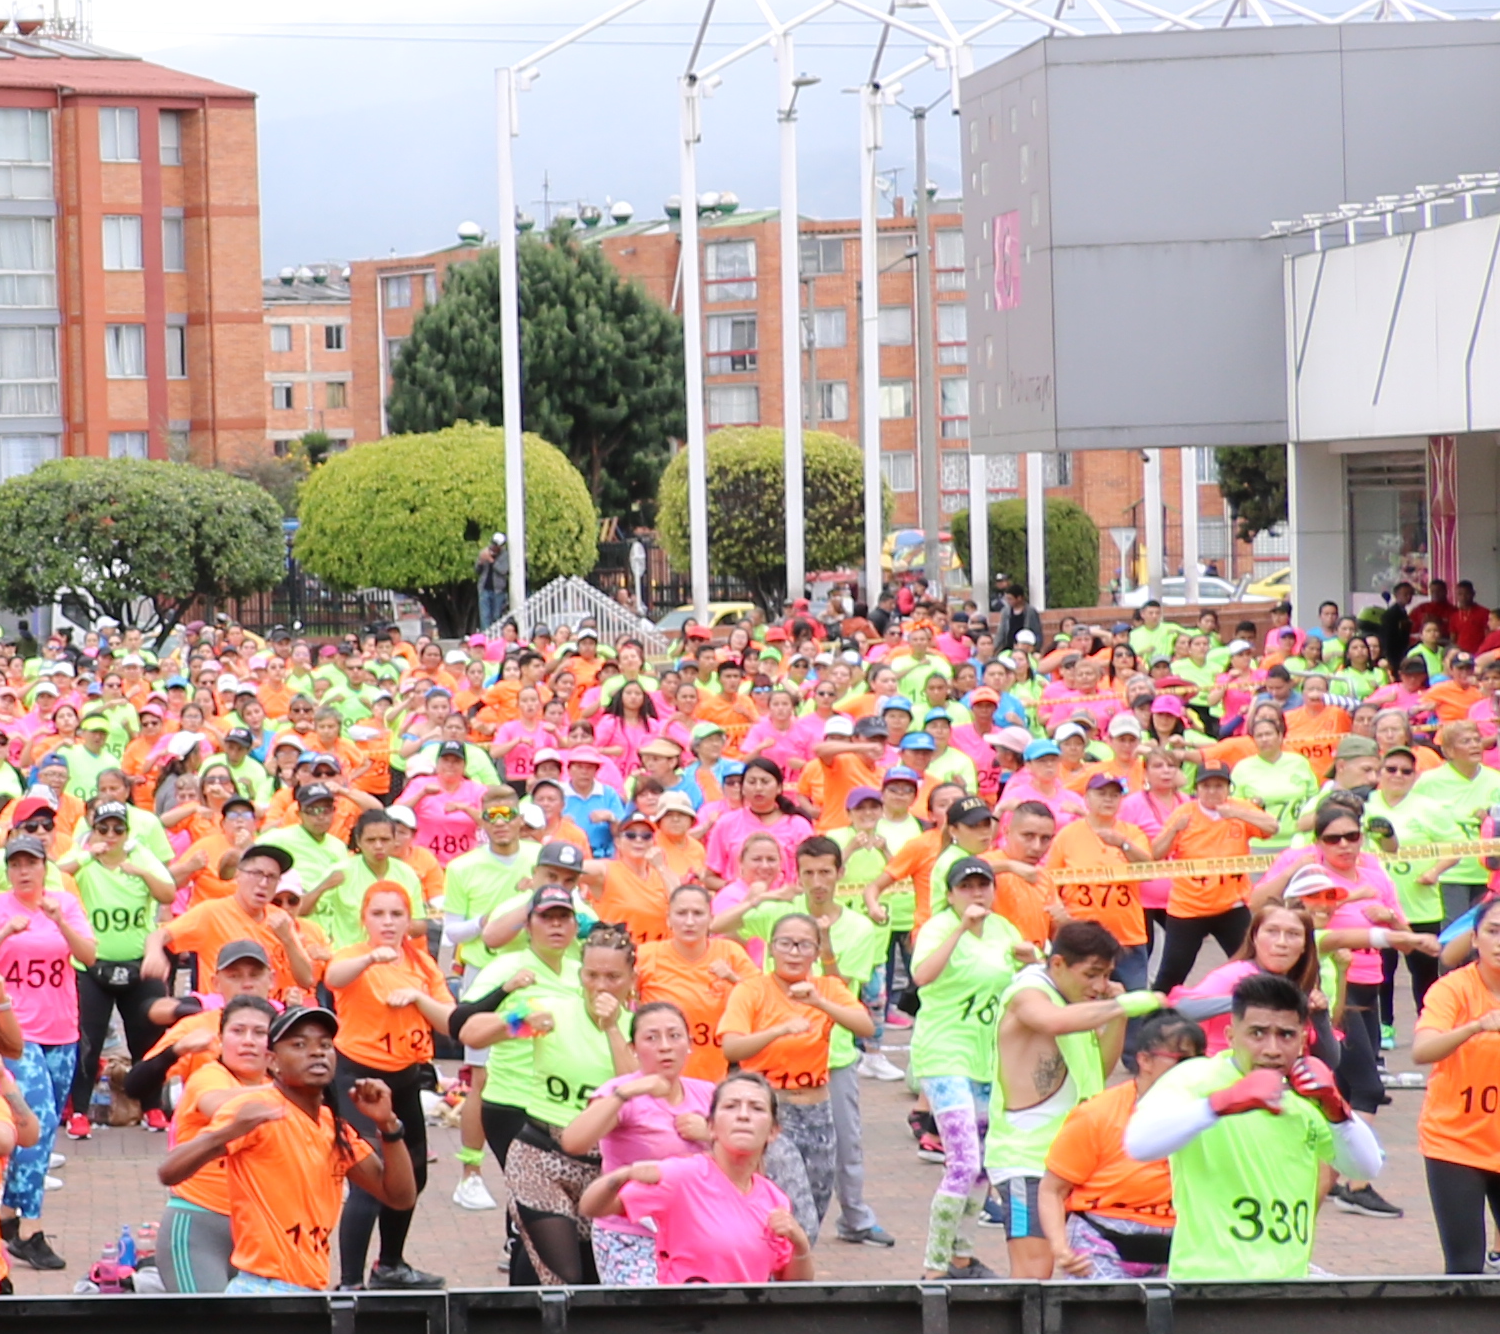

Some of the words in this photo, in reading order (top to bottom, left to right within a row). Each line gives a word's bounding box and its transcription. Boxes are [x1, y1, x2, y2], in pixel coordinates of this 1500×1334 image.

[428, 834, 471, 855] 480
[5, 959, 67, 989] 458
[1229, 1196, 1309, 1245] 330
